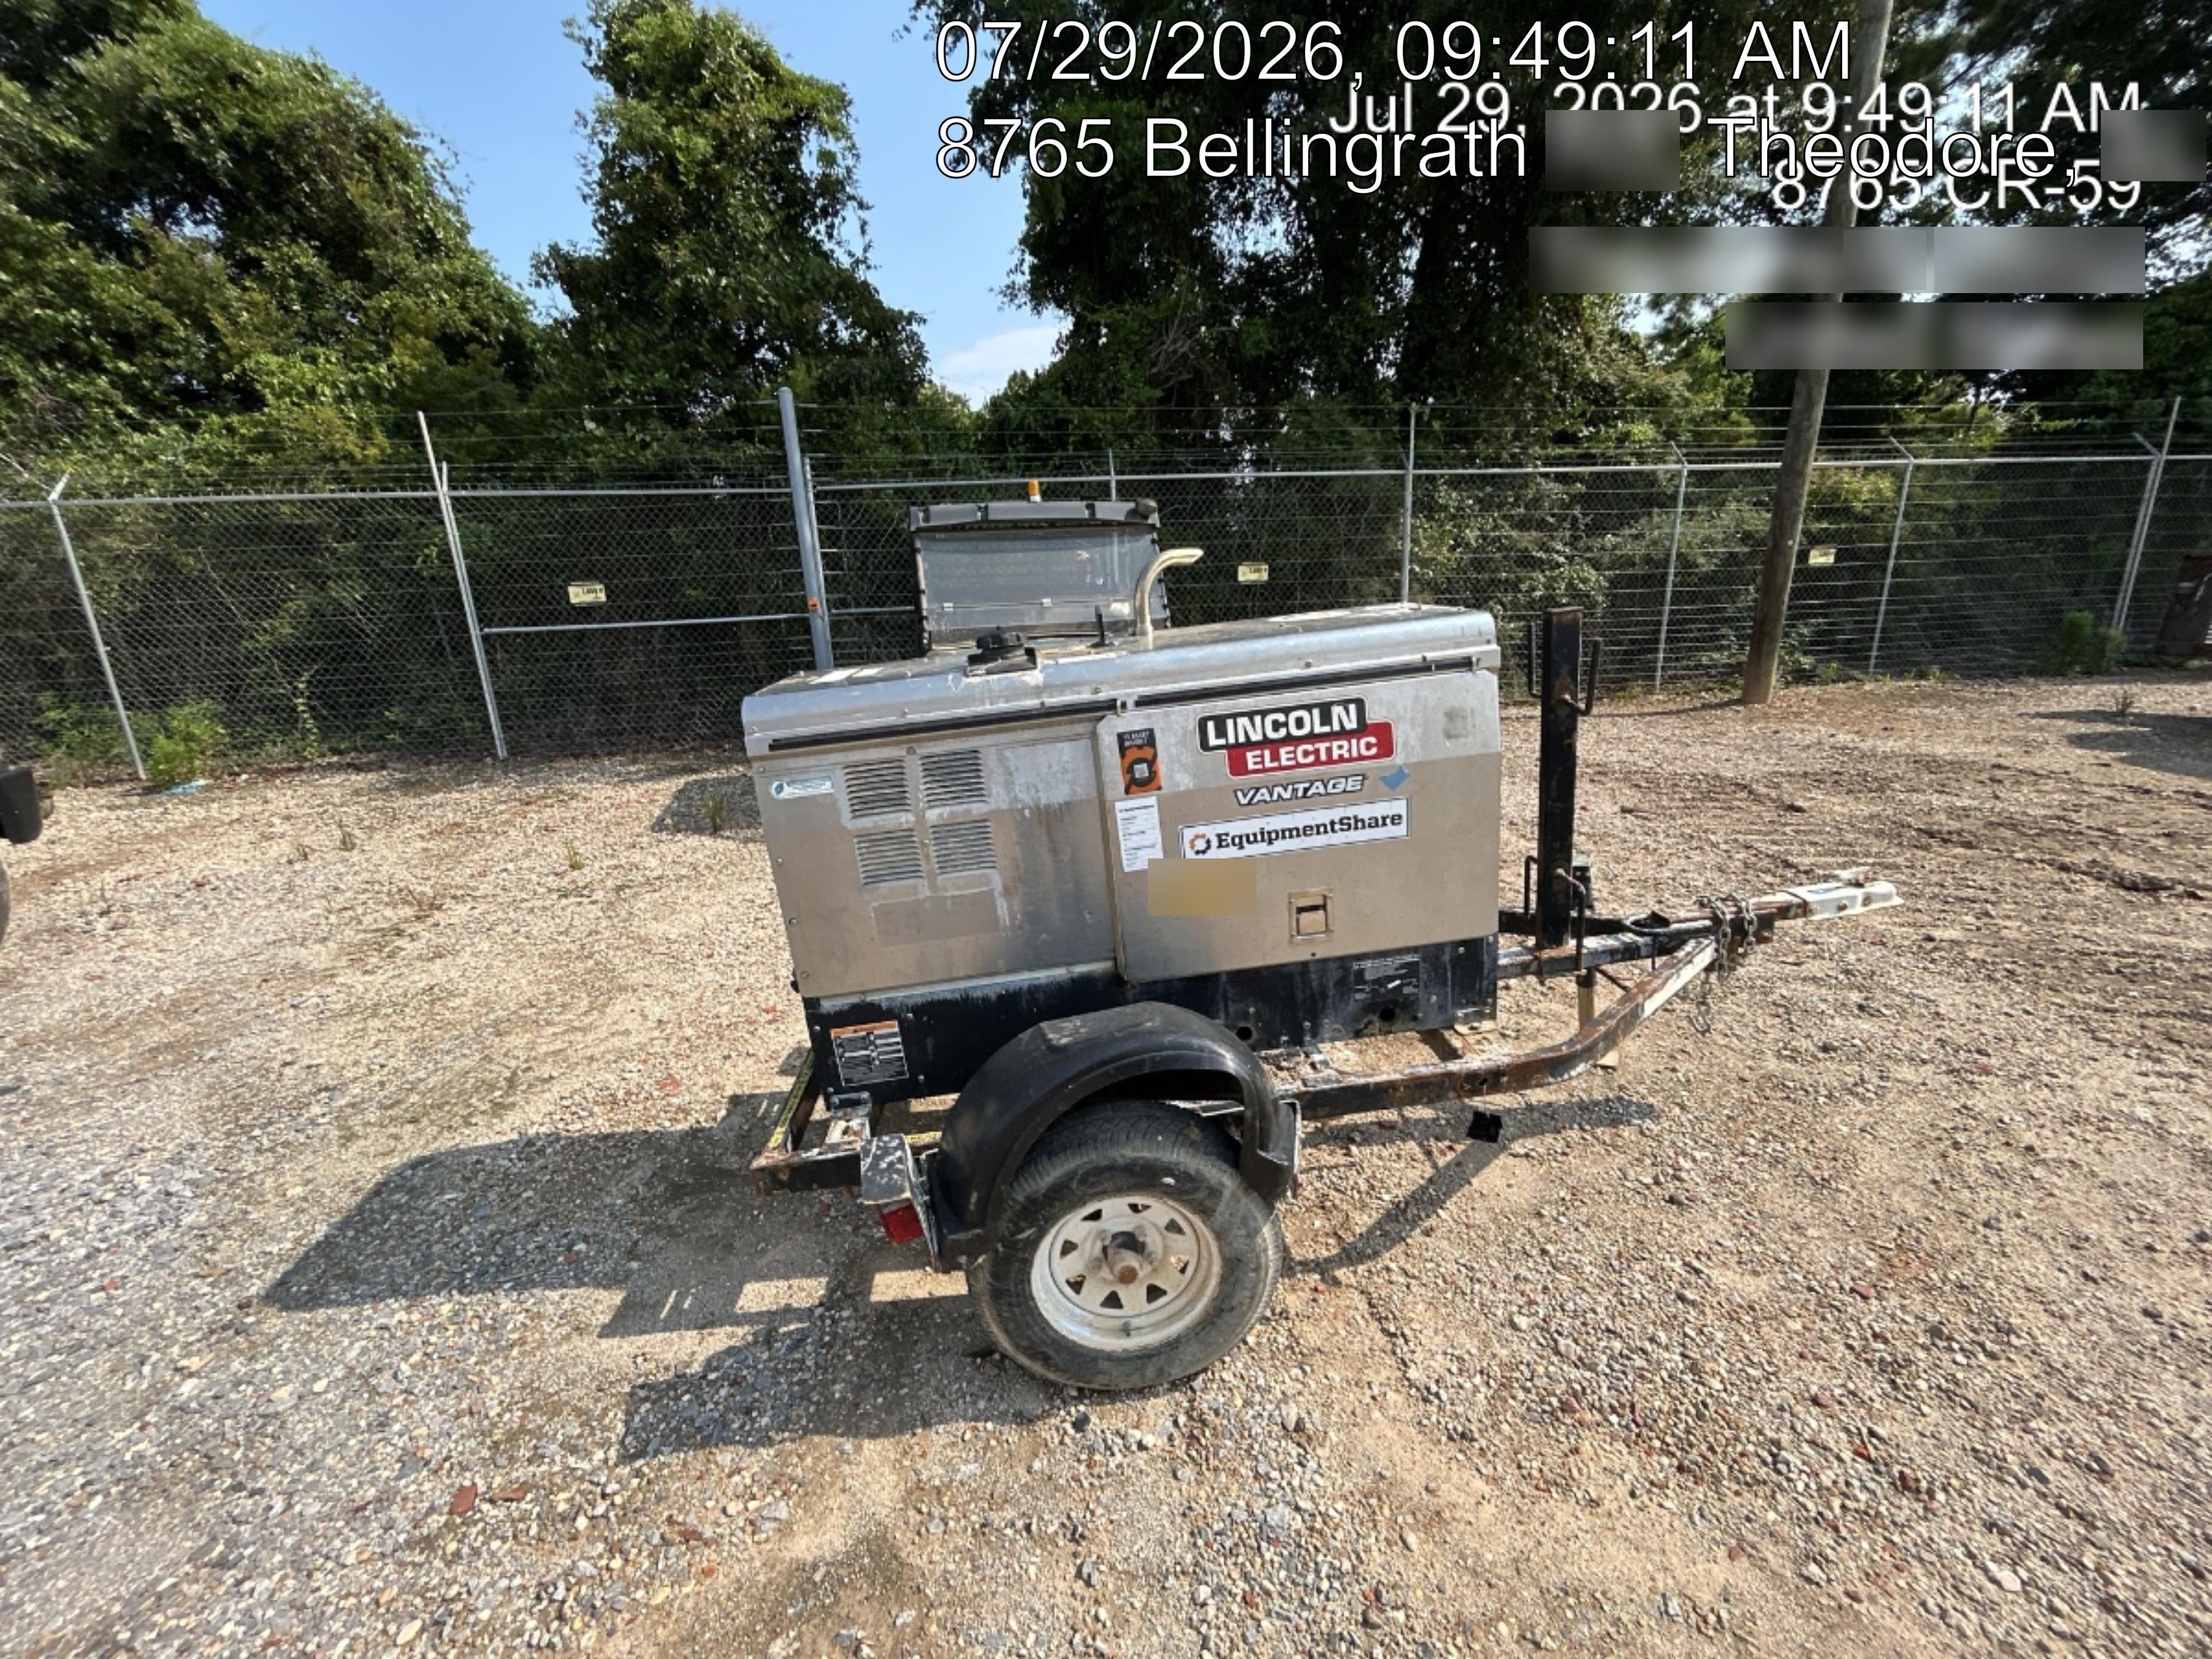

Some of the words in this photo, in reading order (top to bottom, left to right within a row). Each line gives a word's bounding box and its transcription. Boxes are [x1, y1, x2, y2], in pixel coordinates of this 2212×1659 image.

[1206, 703, 1359, 747] LINCOLN
[1245, 735, 1378, 772] ELECTRIC
[1234, 774, 1367, 806] VANTAGE
[1215, 812, 1404, 852] EquipmentShare
